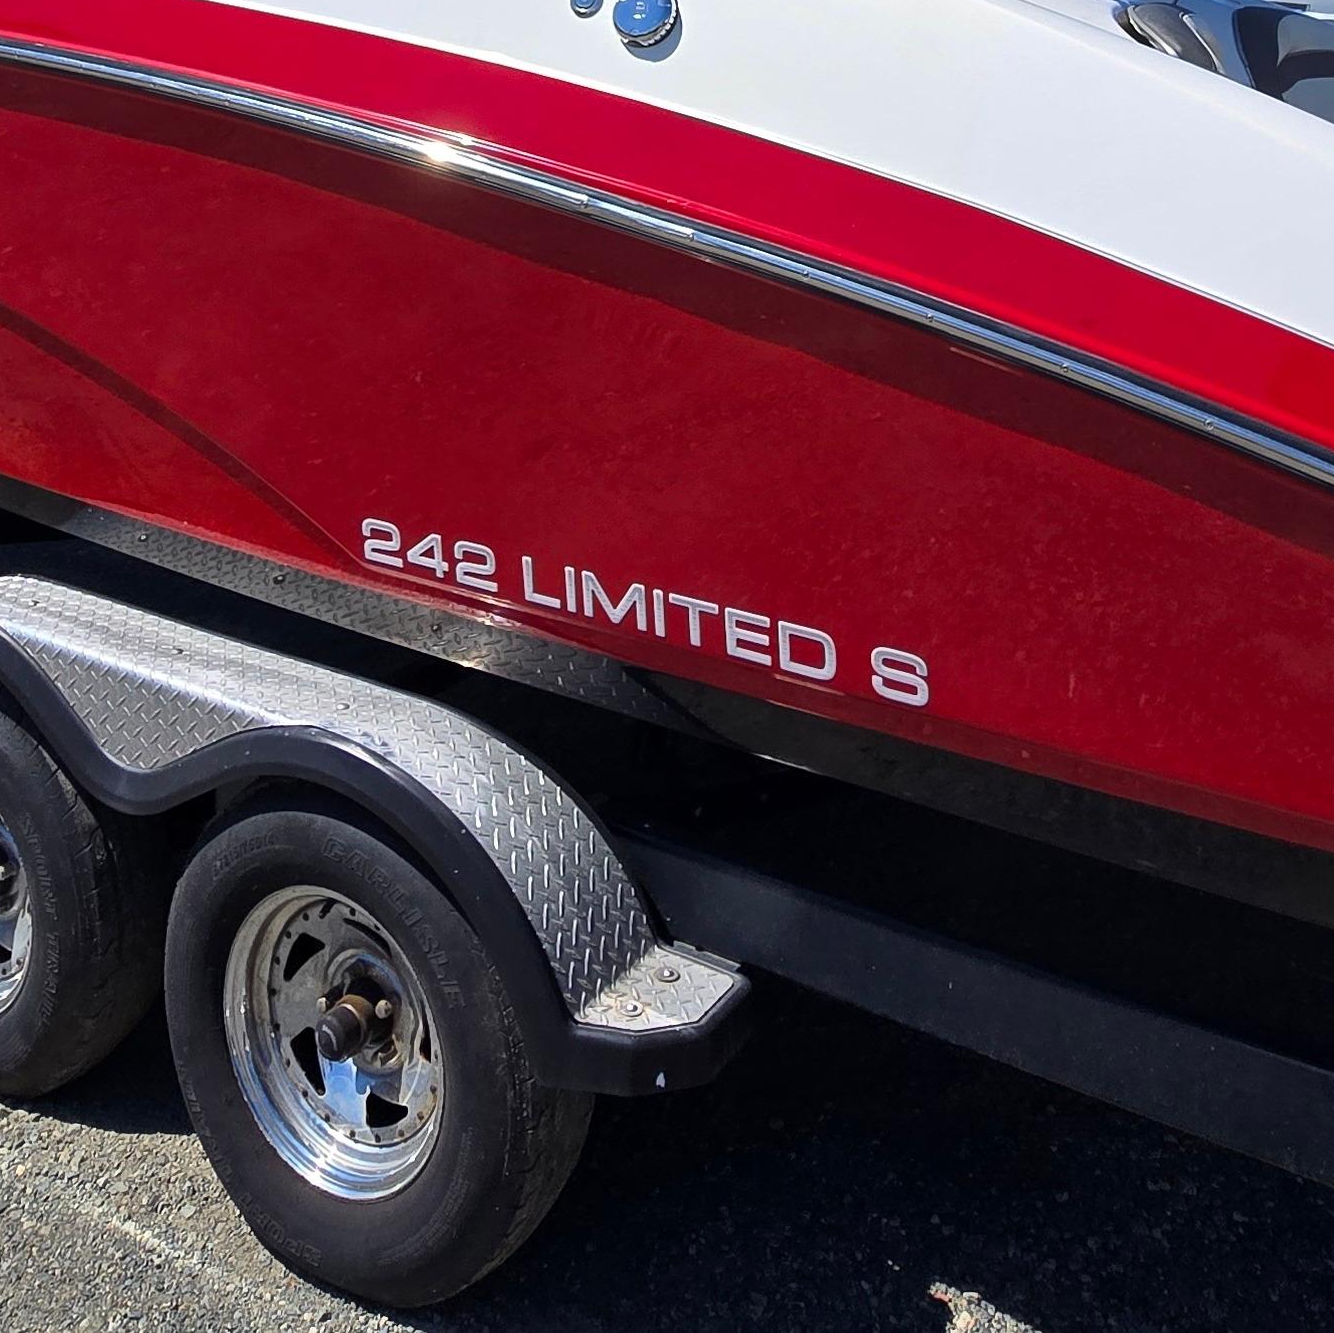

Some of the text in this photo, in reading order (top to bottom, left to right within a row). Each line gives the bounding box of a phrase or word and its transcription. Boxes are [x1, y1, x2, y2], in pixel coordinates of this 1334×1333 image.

[361, 517, 929, 707] 242 LIMITED S
[320, 834, 467, 1011] CARLISLE
